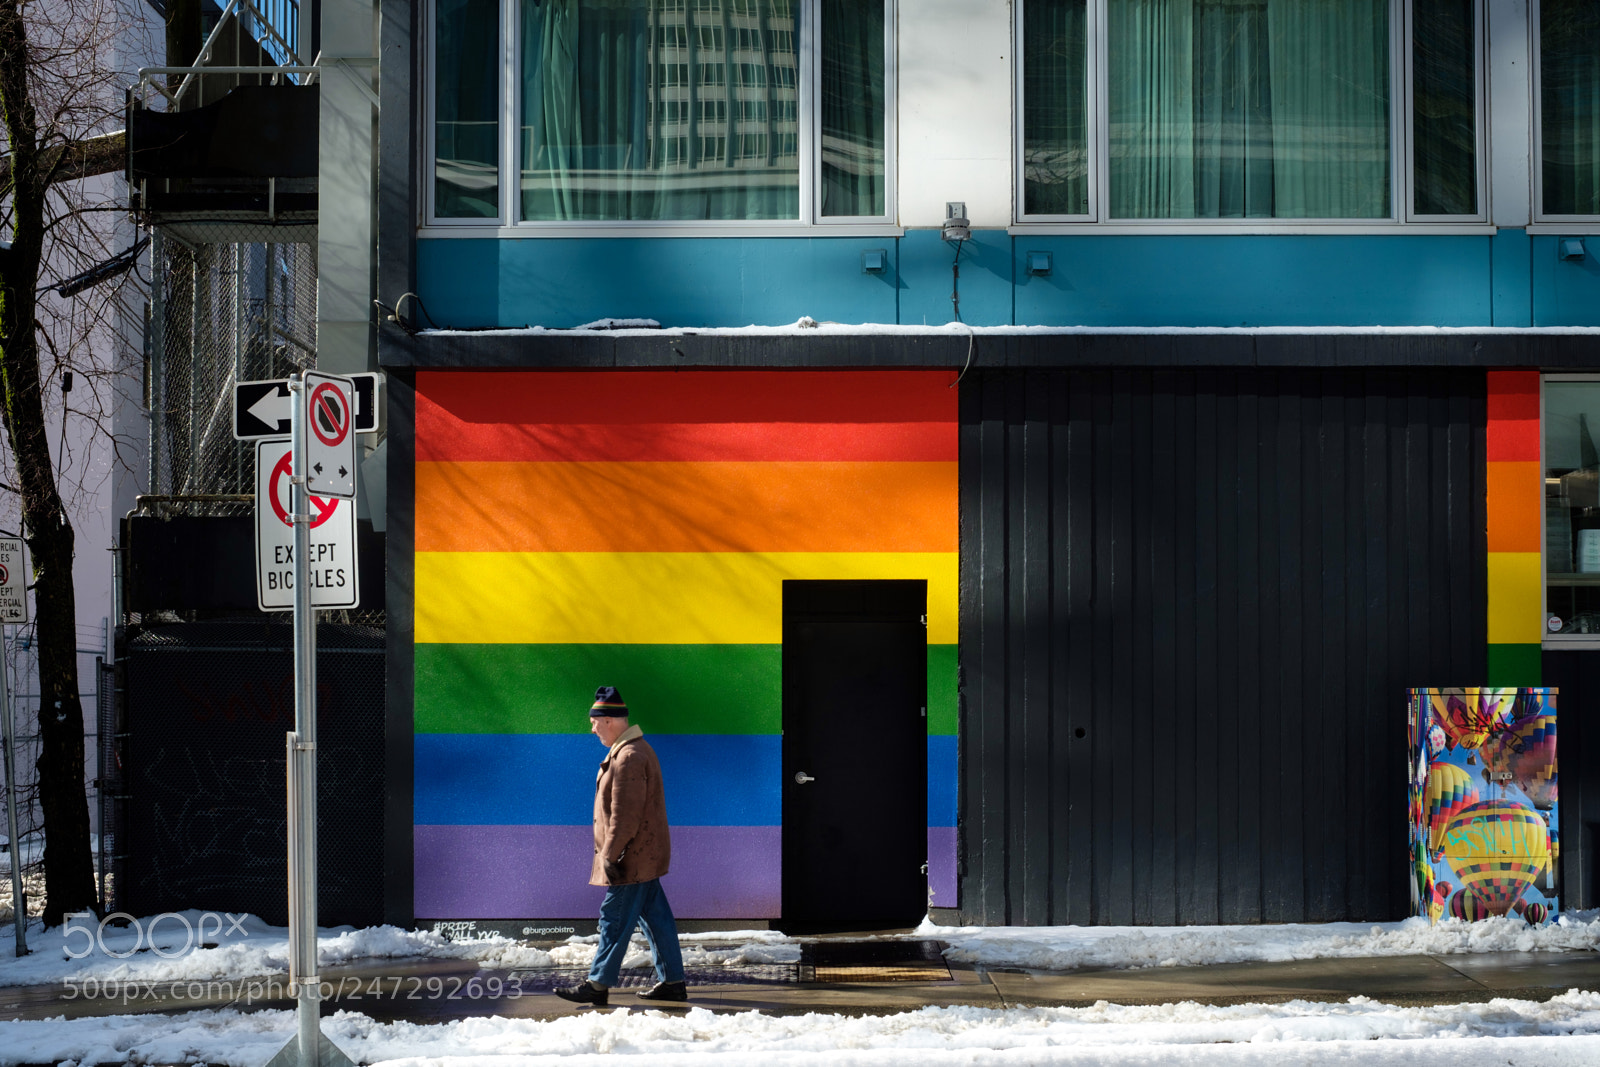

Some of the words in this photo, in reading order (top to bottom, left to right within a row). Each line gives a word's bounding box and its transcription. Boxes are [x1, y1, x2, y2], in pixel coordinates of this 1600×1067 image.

[275, 543, 336, 564] EXEPT
[268, 568, 345, 590] BICLES
[522, 926, 575, 935] @burgoobistro
